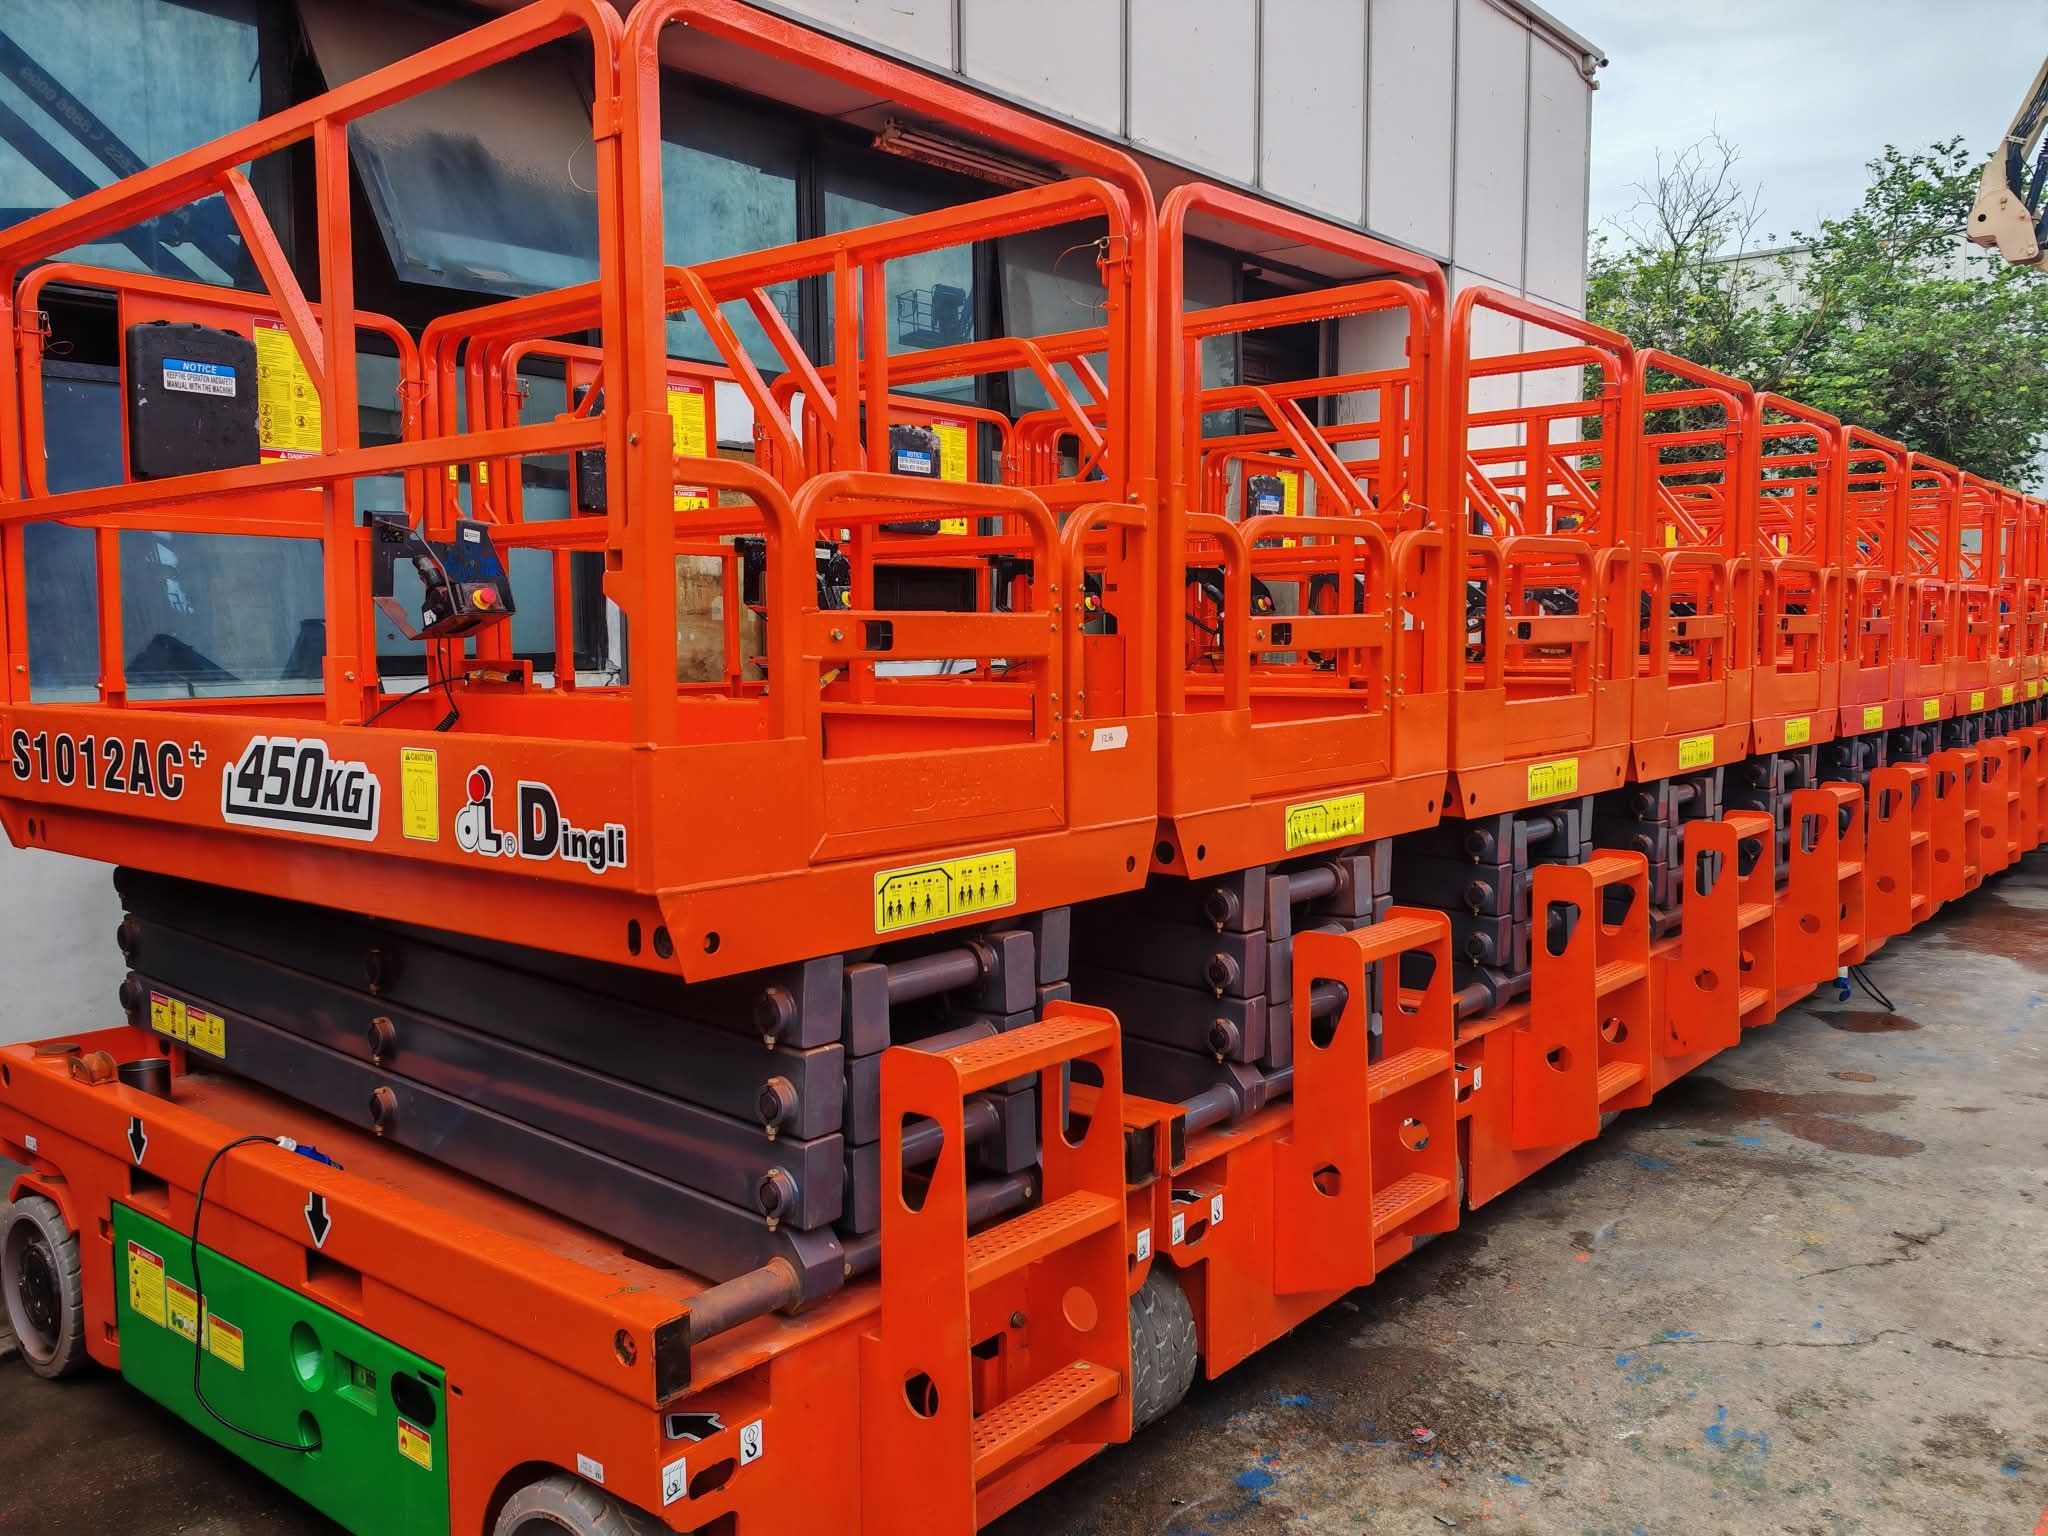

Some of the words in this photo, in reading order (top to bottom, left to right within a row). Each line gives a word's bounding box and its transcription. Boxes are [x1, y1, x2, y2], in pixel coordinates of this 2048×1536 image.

[182, 361, 218, 375] NOTICE
[187, 373, 209, 384] OPERATION
[166, 380, 188, 390] MANUAL
[202, 383, 212, 393] THE
[410, 752, 433, 762] CAUTION
[237, 744, 365, 814] 450KG
[519, 783, 626, 871] Dingli
